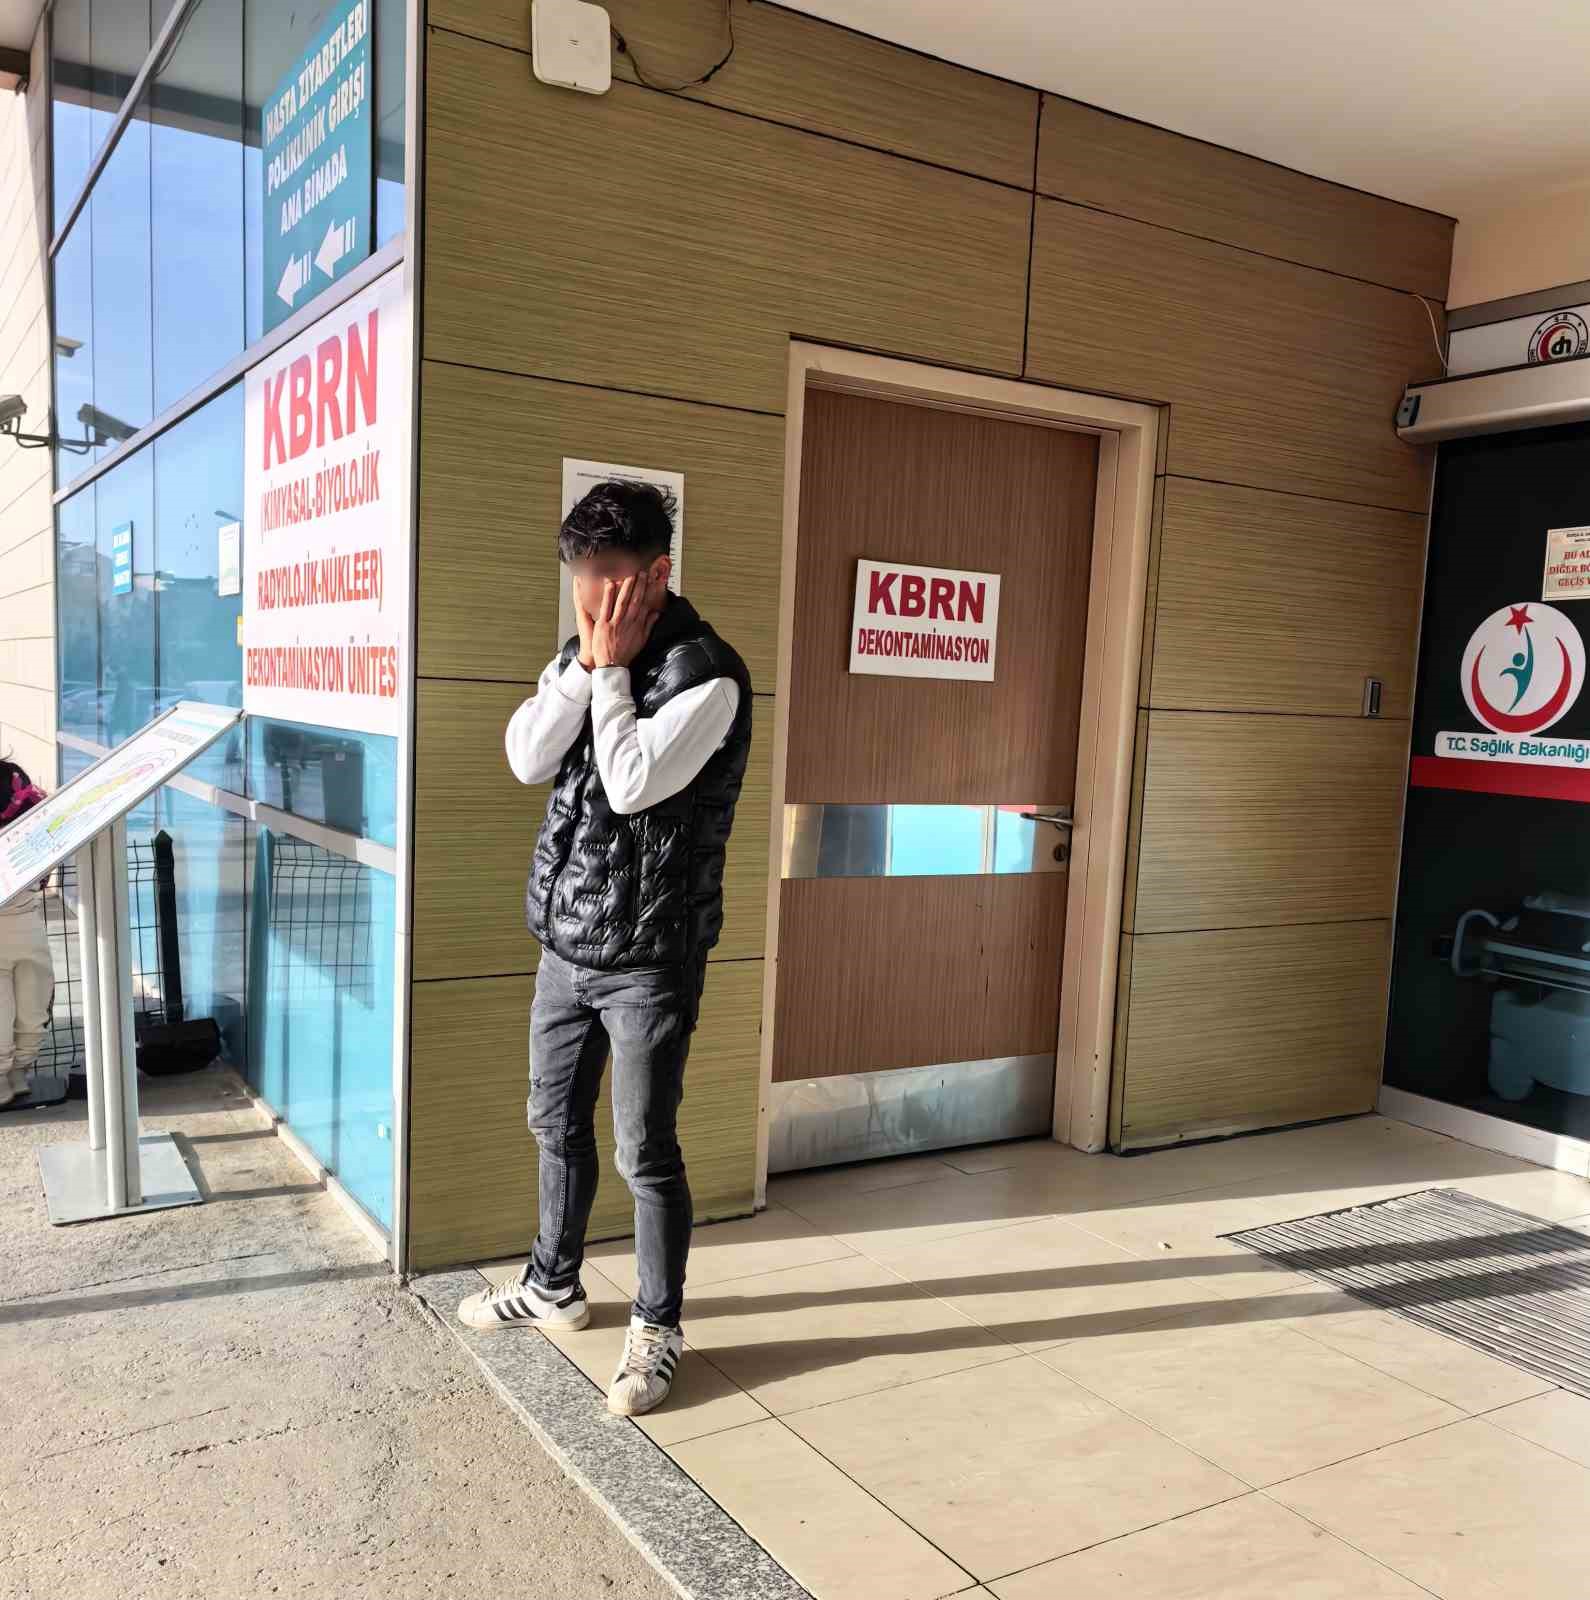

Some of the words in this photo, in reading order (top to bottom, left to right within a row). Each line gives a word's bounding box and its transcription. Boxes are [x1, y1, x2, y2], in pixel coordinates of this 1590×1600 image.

[266, 84, 297, 146] HASTA
[267, 103, 326, 197] POLİKLİNİK
[328, 46, 365, 132] GİRİŞİ
[280, 188, 302, 237] ANA
[304, 143, 347, 215] BİNADA
[263, 307, 379, 471] KBRN
[261, 440, 381, 544] (KİMYASAL-BİYOLOJİK
[257, 544, 383, 613] RADYOLOJİK-NÜKLEER)
[1563, 550, 1578, 560] BU
[867, 570, 986, 624] KBRN
[247, 633, 344, 693] DEKONTAMİNASYON
[857, 627, 989, 664] DEKONTAMİNASYON
[1447, 737, 1467, 751] T.C.
[1469, 737, 1515, 757] Sağlık
[1518, 741, 1590, 763] Bakanlığı
